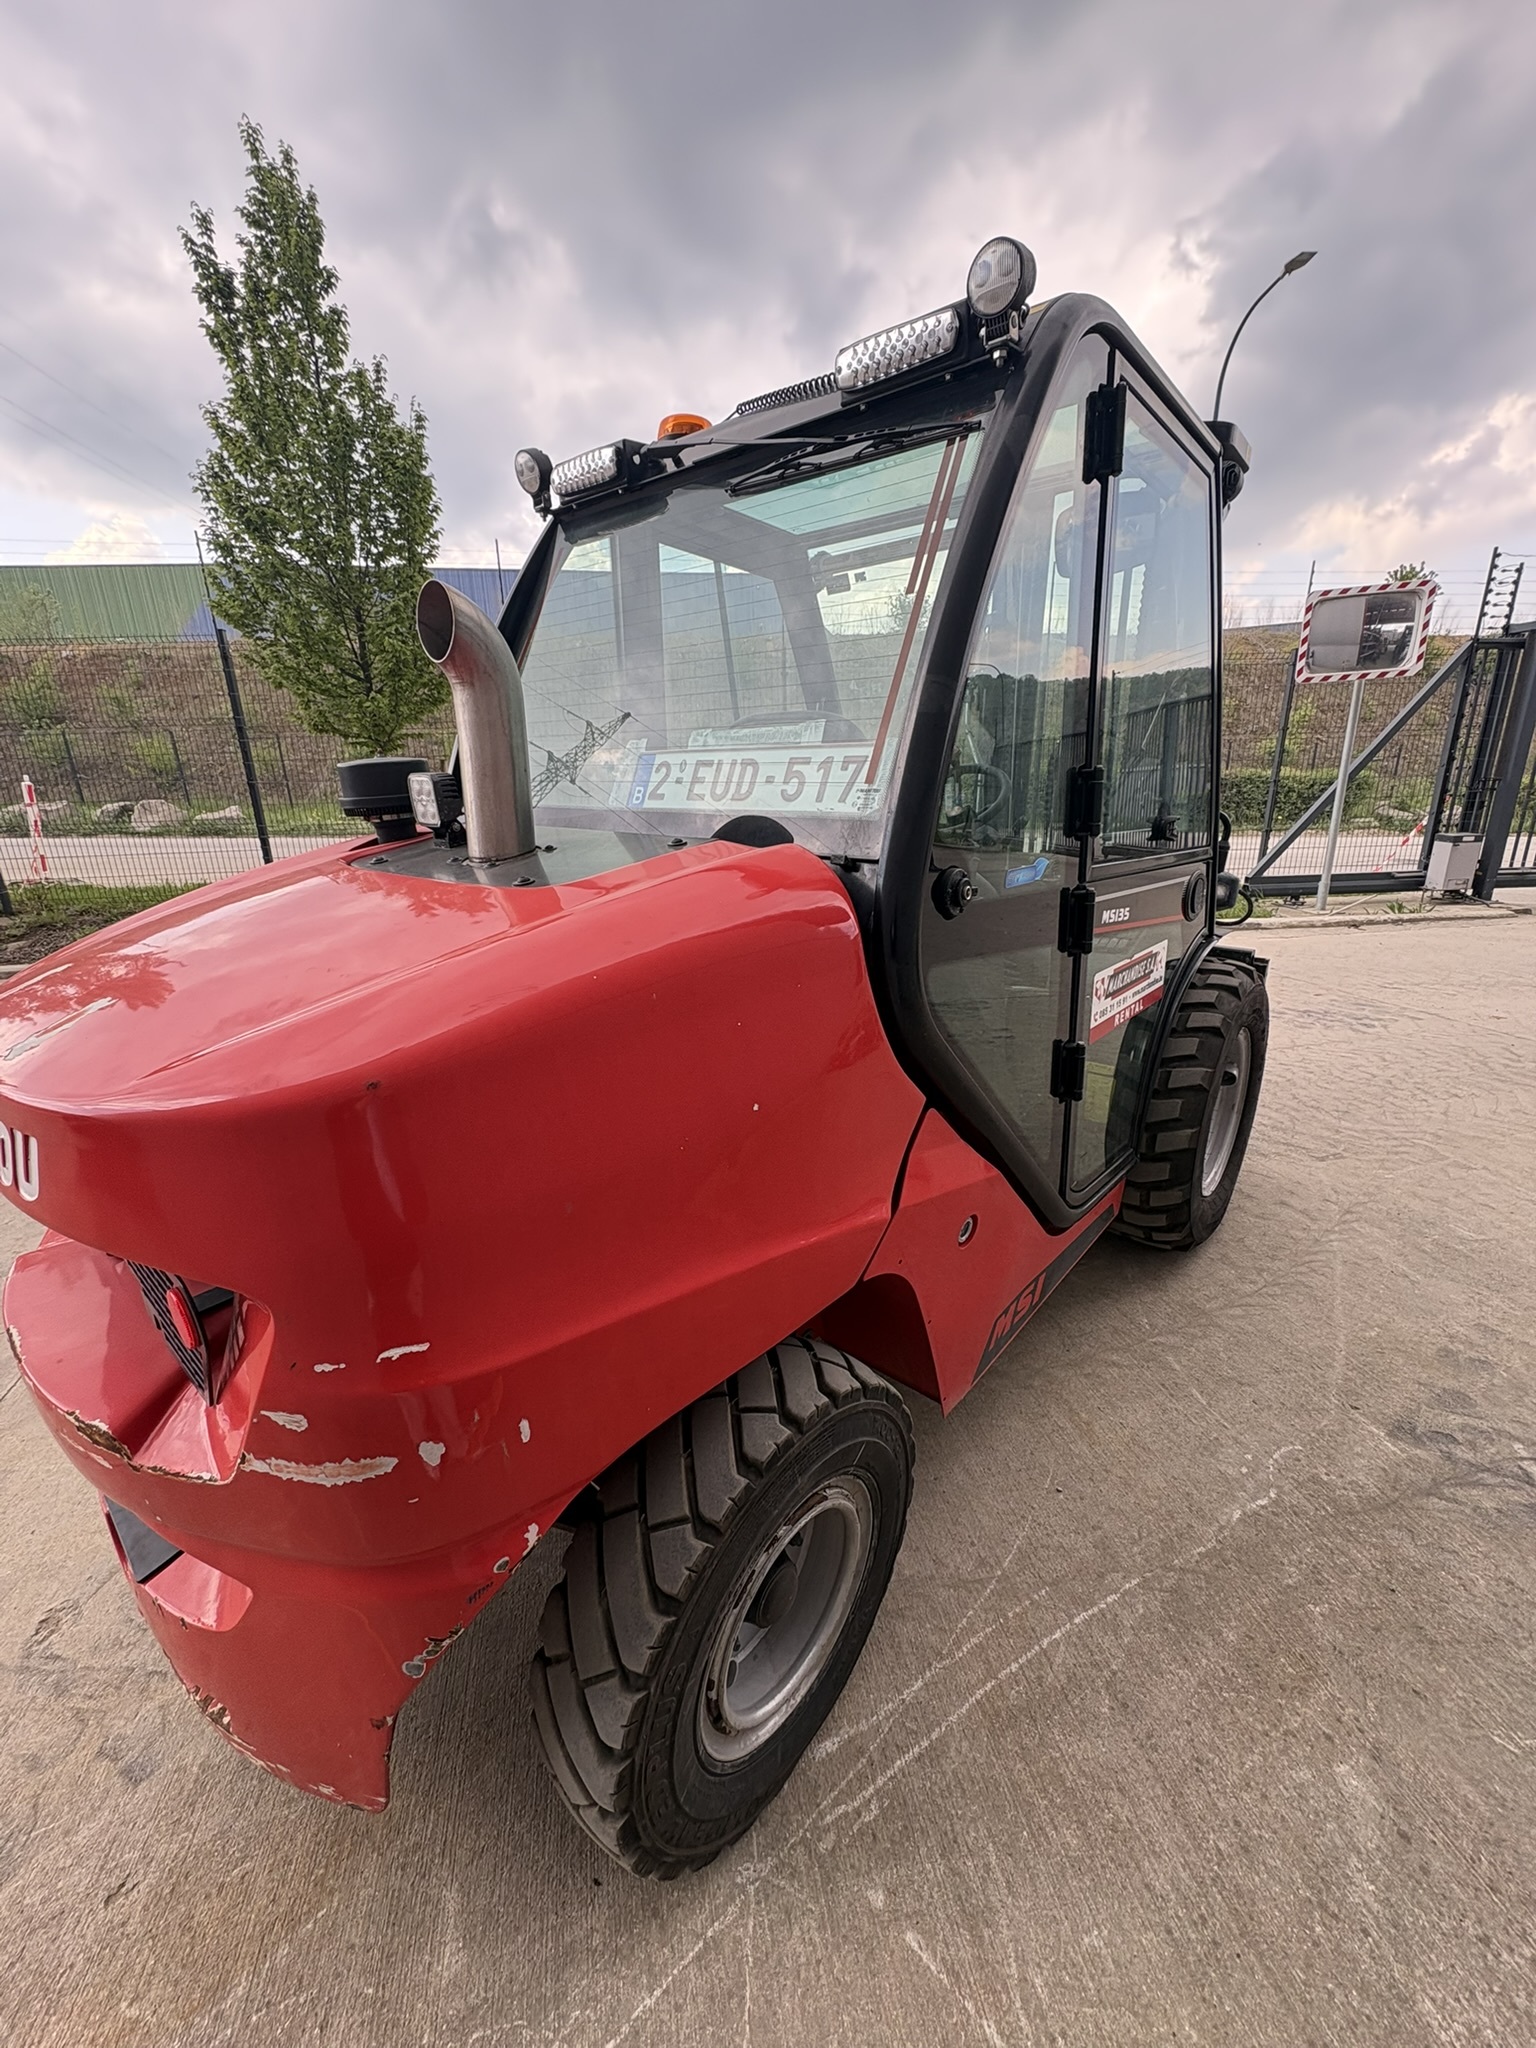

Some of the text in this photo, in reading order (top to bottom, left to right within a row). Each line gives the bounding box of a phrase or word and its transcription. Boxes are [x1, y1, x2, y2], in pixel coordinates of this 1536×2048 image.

[632, 786, 644, 804] B
[647, 755, 869, 804] 2-EUD-517
[1114, 999, 1144, 1027] RENTAL
[988, 1272, 1047, 1352] MSI
